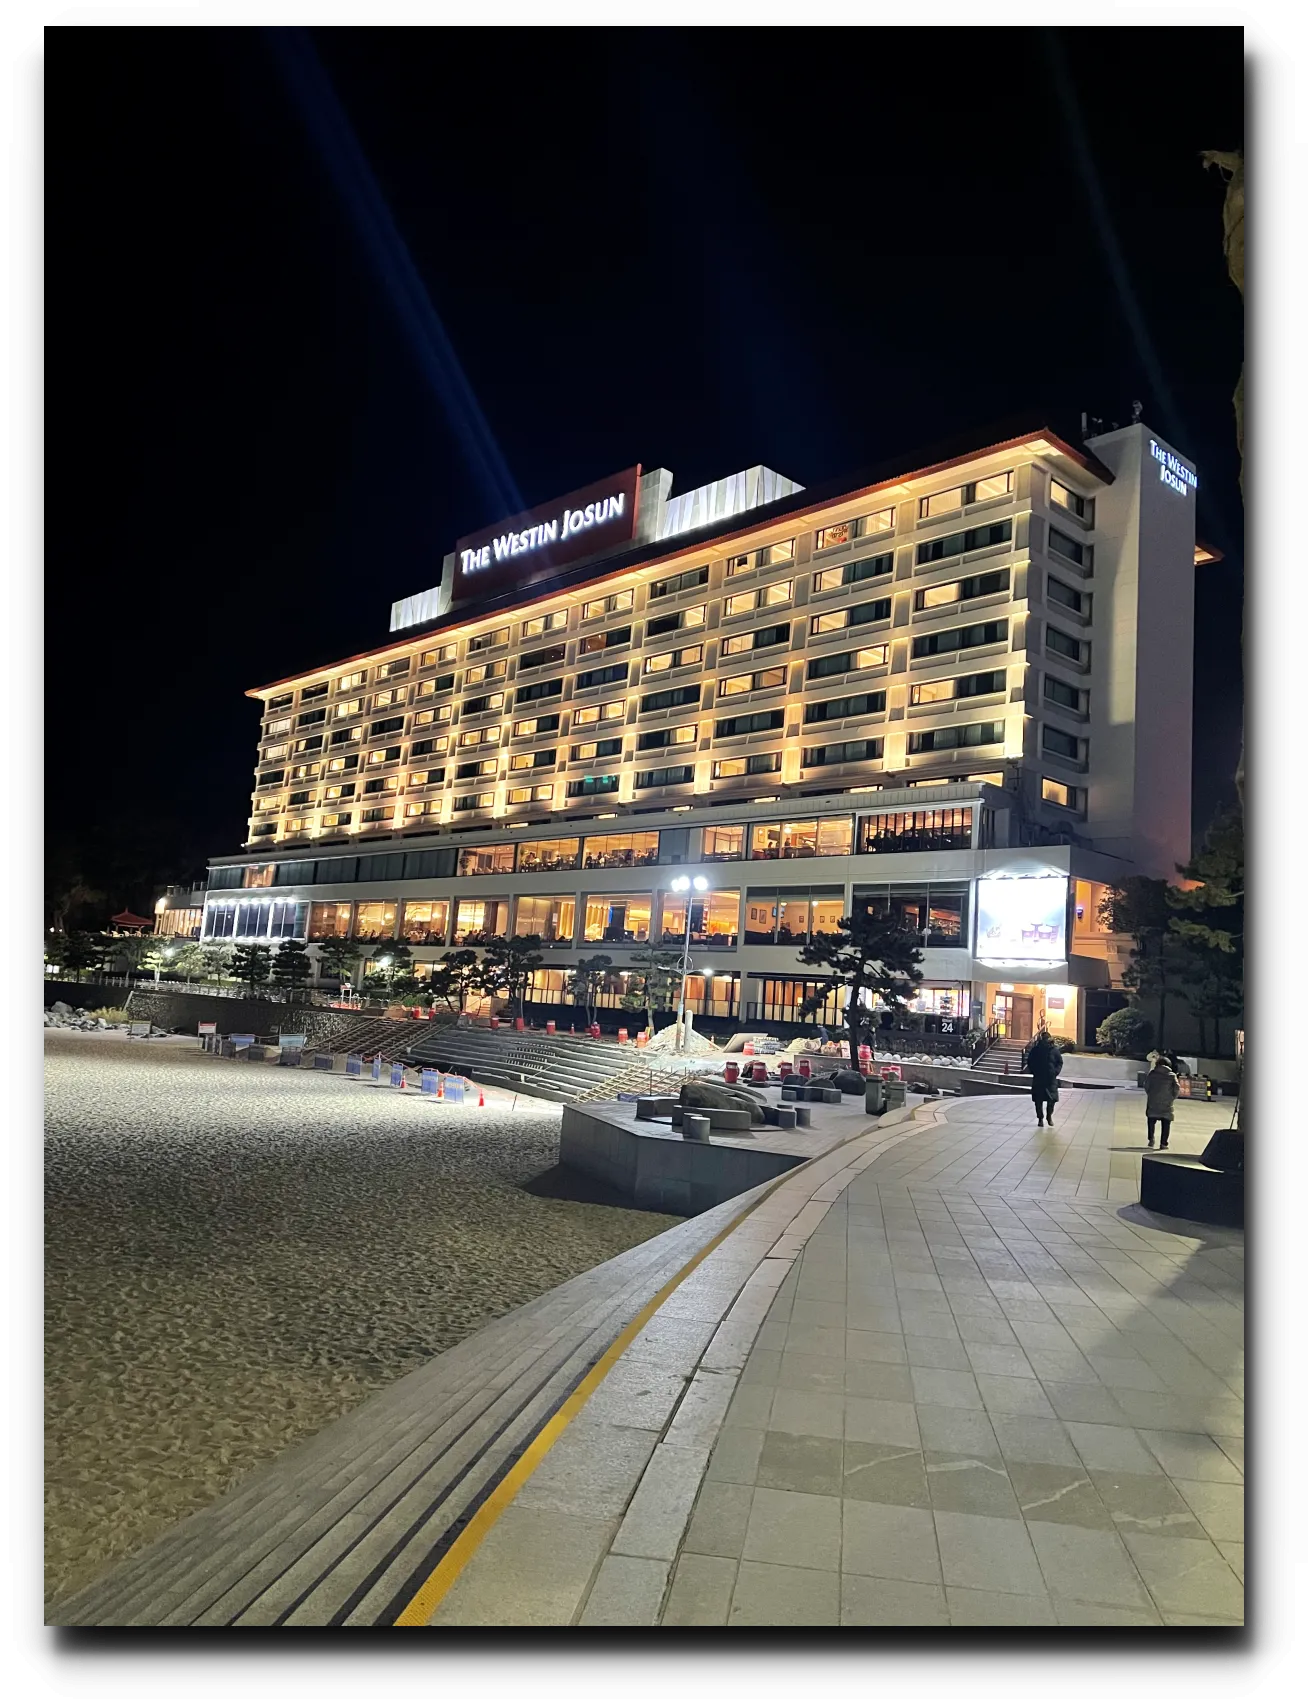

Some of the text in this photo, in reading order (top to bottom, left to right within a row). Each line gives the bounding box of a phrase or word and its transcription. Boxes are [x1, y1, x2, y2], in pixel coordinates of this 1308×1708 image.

[1149, 439, 1198, 489] THE WESTIN
[1160, 464, 1188, 497] JOSUN
[460, 492, 626, 575] THE WESTIN JOSUN
[941, 1022, 954, 1033] 24
